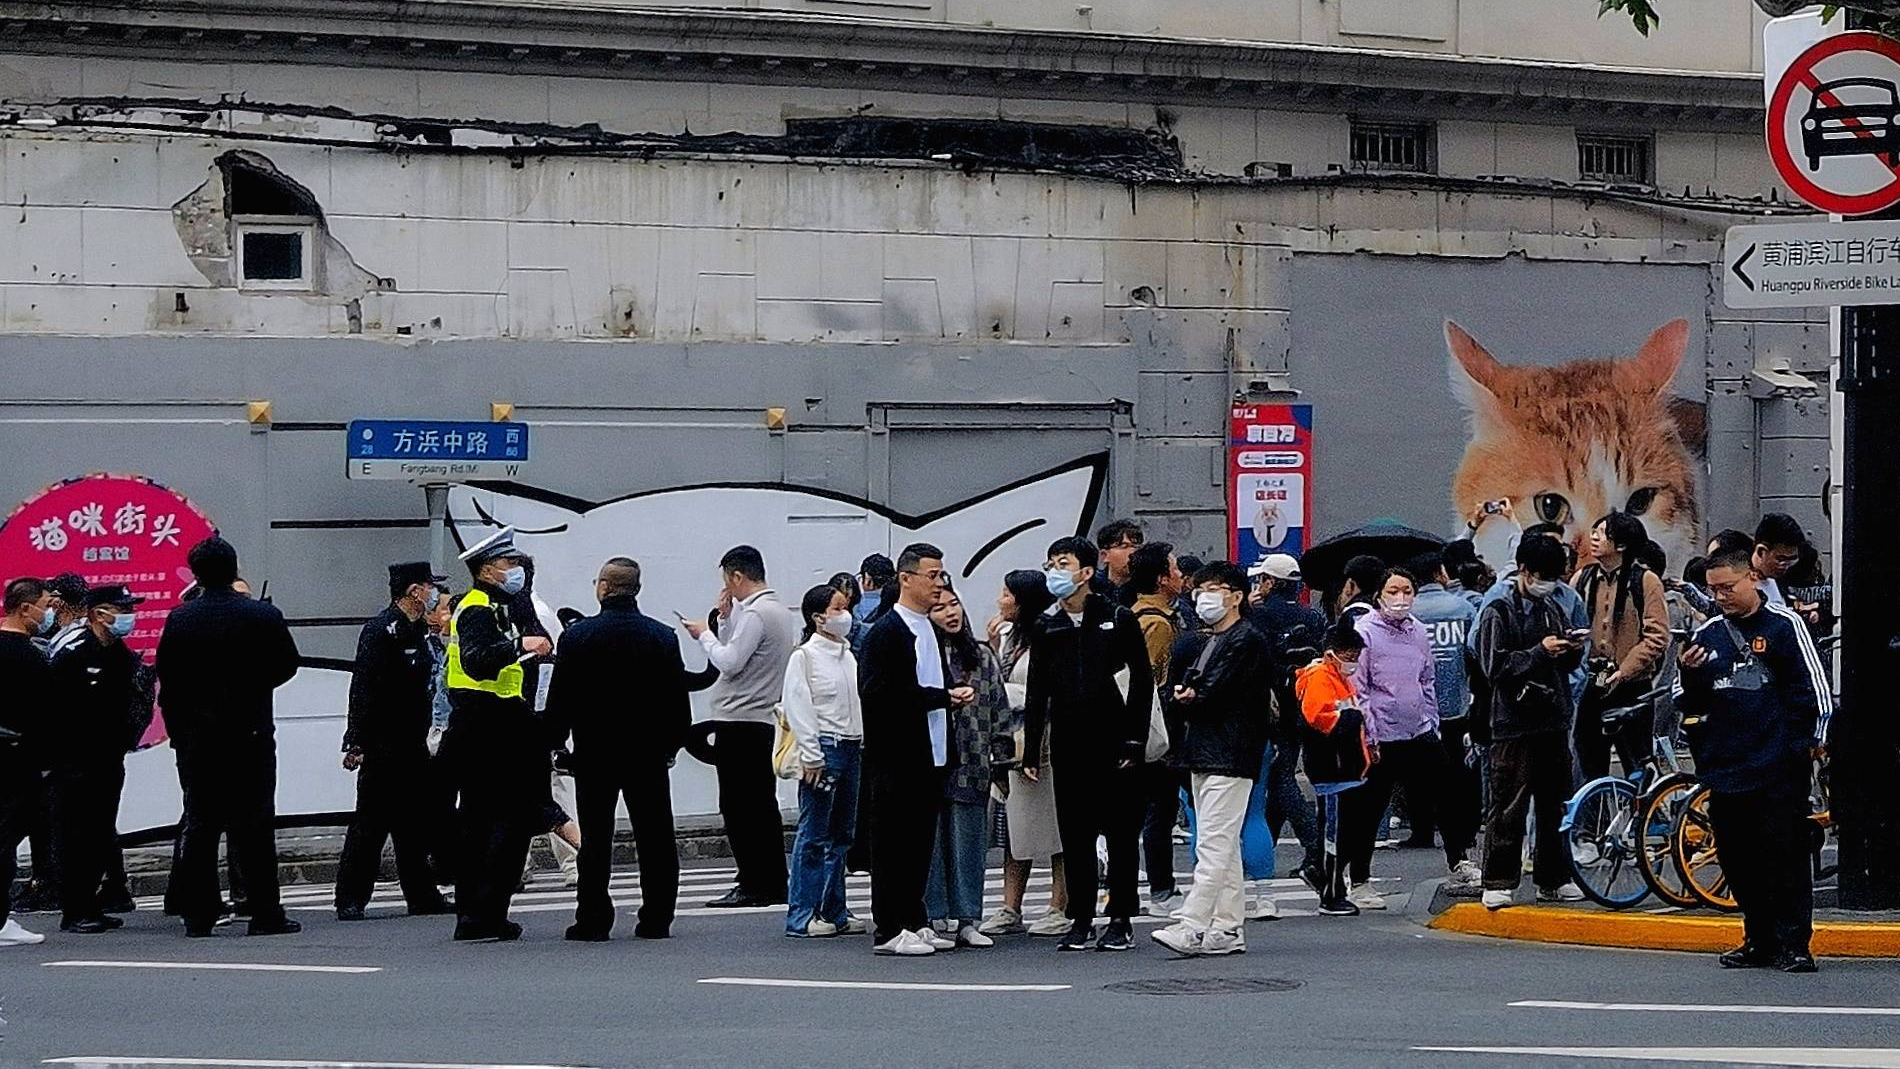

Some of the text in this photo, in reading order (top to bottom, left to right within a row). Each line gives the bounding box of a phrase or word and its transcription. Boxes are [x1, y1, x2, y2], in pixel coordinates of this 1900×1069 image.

[1761, 279, 1811, 294] Huangpu
[1814, 276, 1862, 291] Riverside
[1865, 275, 1888, 289] Bike
[392, 428, 489, 455] 方浜中路
[505, 428, 520, 444] 西
[362, 463, 372, 475] E
[400, 463, 447, 476] Fangbang
[505, 464, 519, 476] W
[29, 502, 181, 551] 猫咪街头
